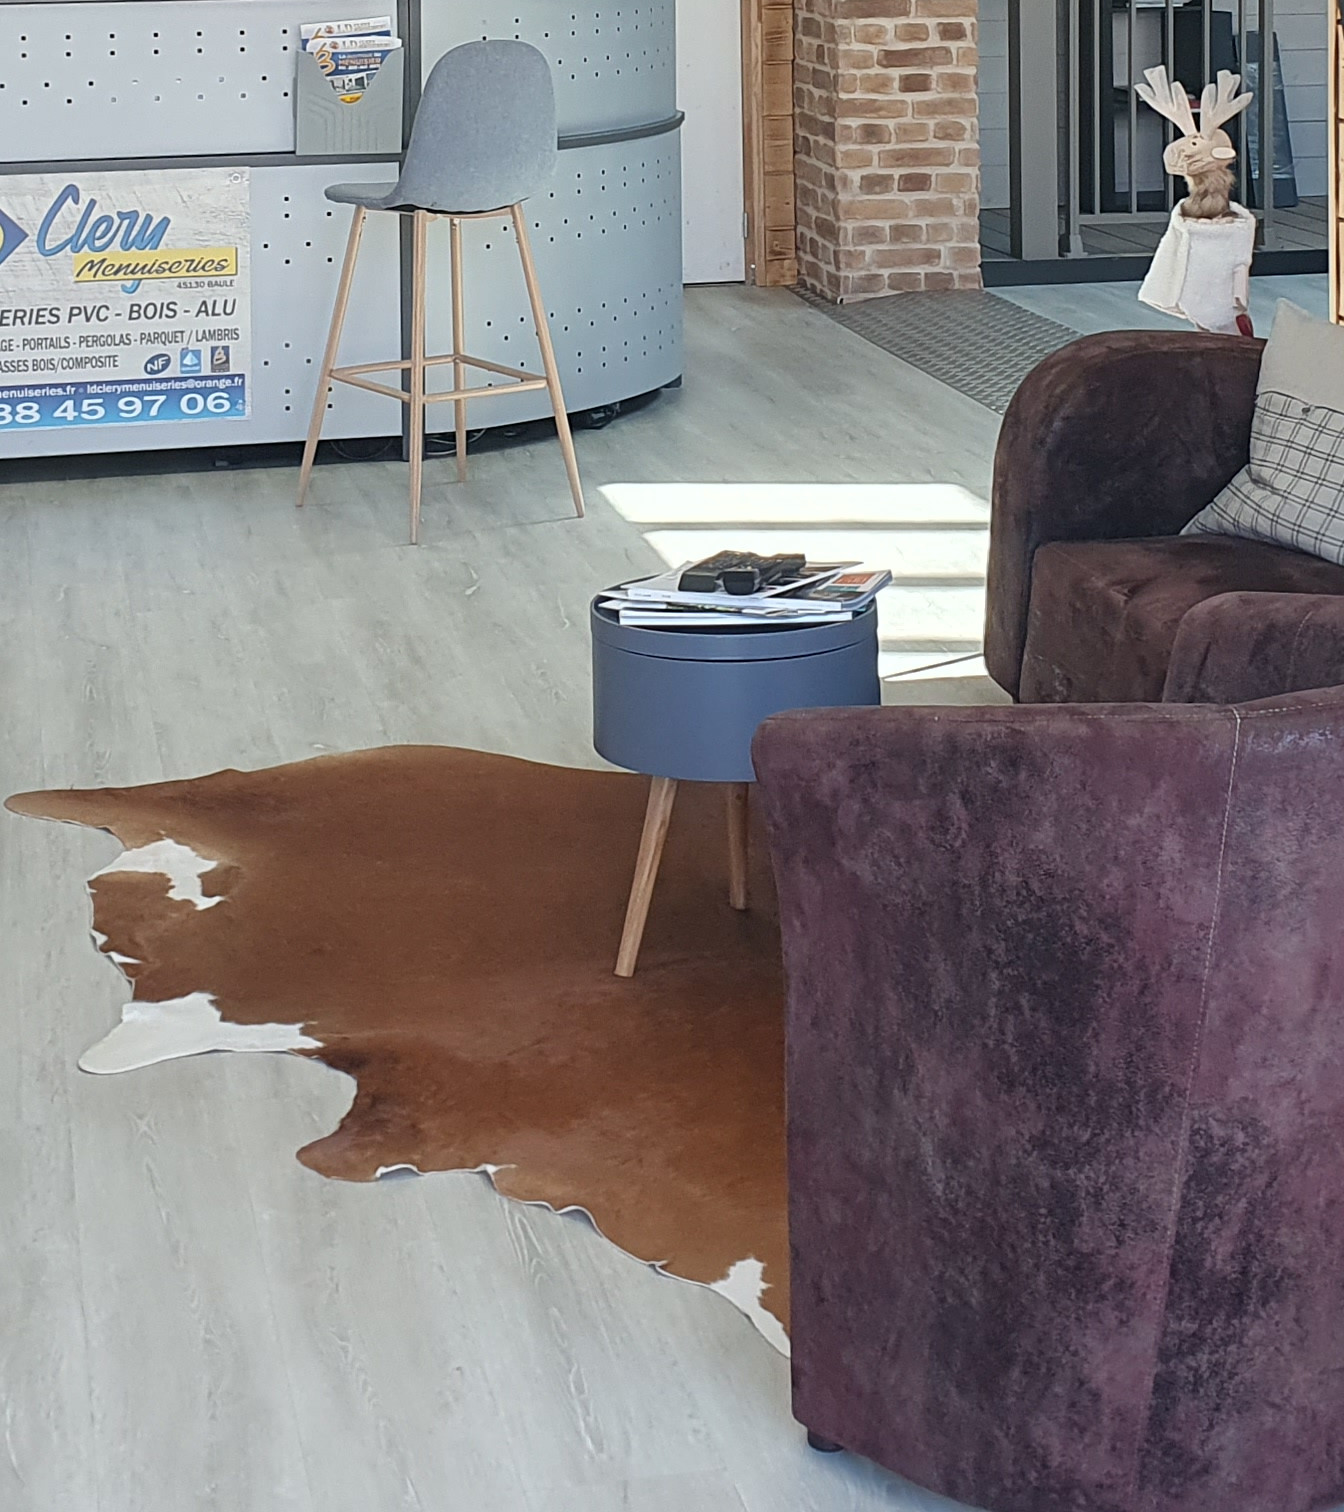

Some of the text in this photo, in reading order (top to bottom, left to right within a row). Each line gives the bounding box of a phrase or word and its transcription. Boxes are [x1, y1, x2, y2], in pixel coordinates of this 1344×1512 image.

[36, 184, 171, 294] Clery
[75, 257, 230, 279] Menuiseries
[176, 279, 235, 289] 45130 BAULE
[67, 304, 110, 324] PVC
[128, 301, 178, 321] BOIS
[195, 298, 237, 318] ALU
[22, 336, 71, 352] PORTAILS
[78, 333, 132, 349] PERGOLAS
[139, 330, 185, 346] PARQUET
[195, 328, 240, 343] LAMBRIS
[31, 355, 119, 374] BOIS/COMPOSITE
[146, 356, 169, 374] NF
[87, 377, 243, 395] ldclerymenuiseries@orange.fr
[52, 399, 106, 421] 45
[117, 395, 167, 418] 97
[179, 392, 231, 415] 06
